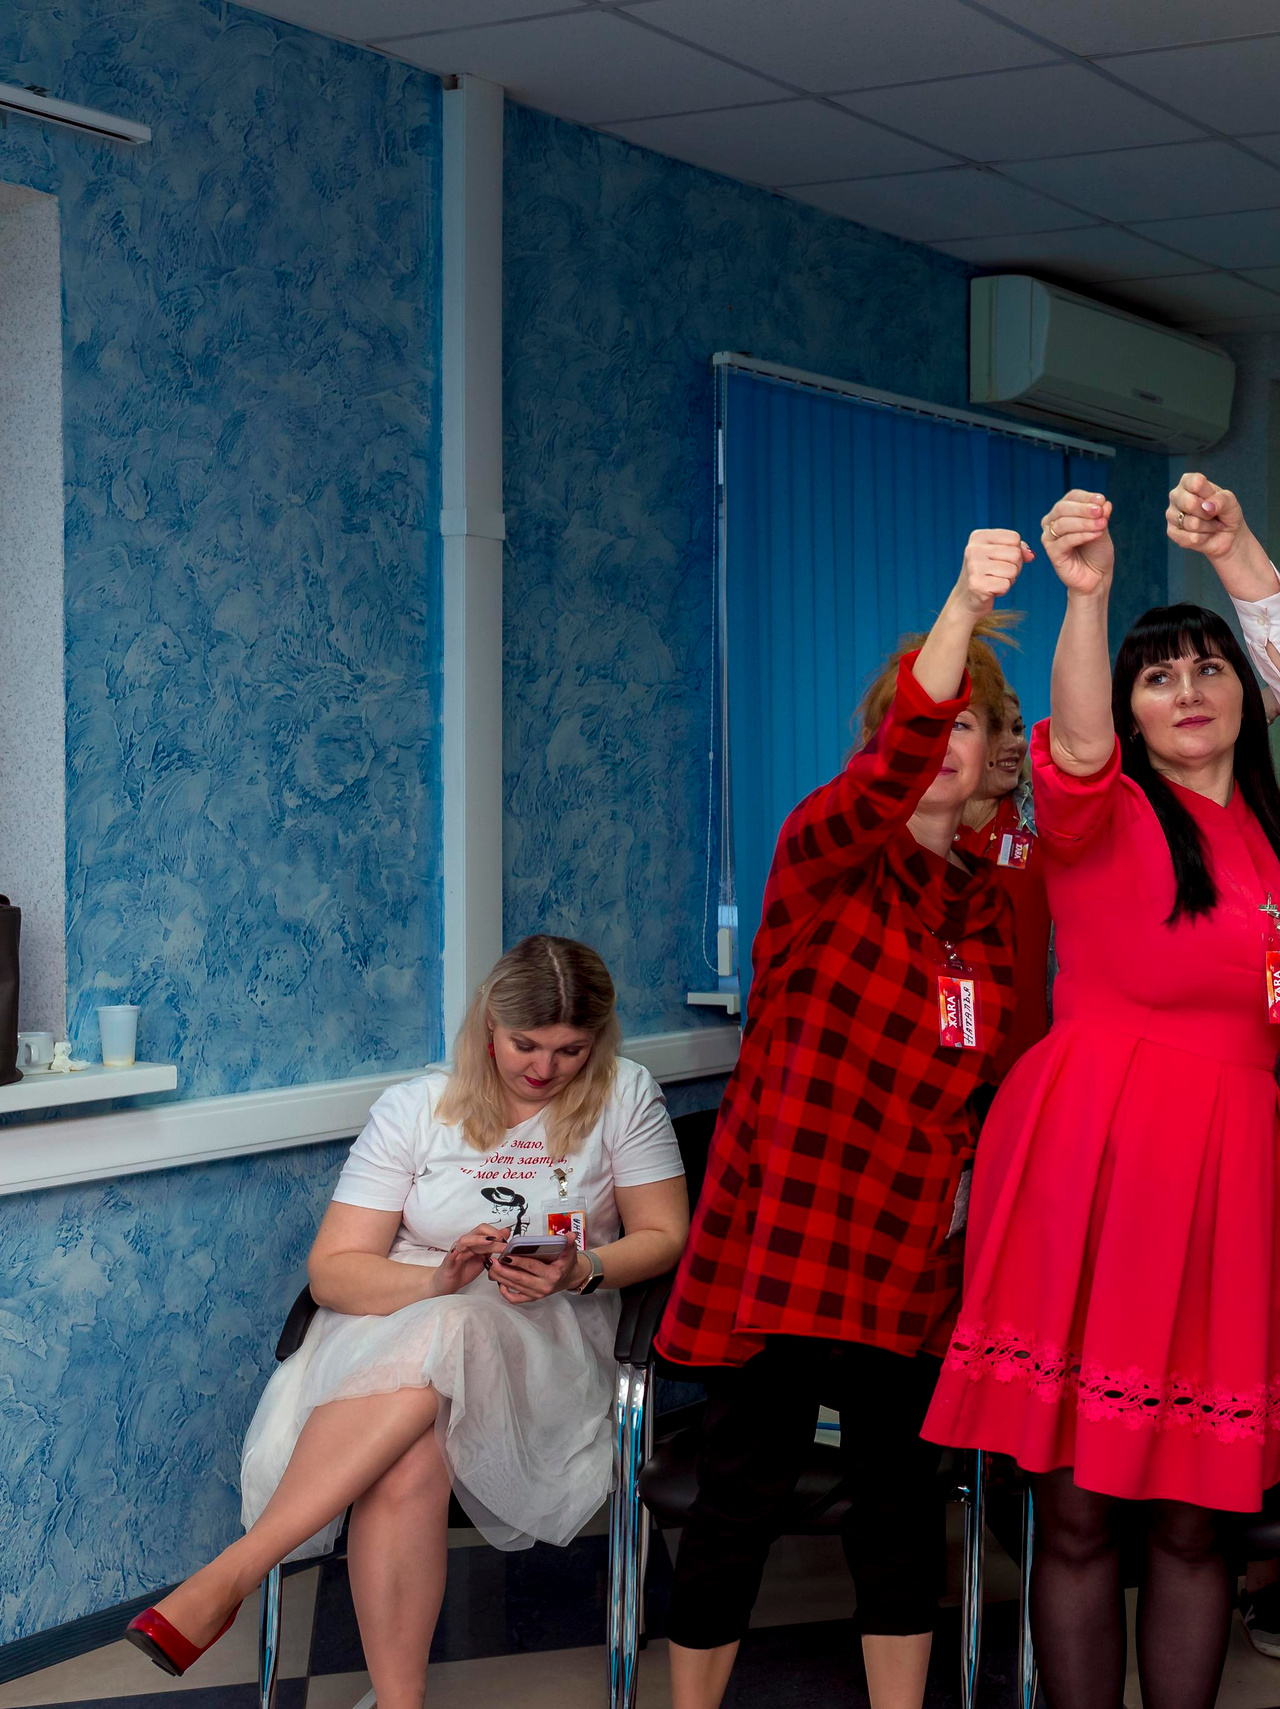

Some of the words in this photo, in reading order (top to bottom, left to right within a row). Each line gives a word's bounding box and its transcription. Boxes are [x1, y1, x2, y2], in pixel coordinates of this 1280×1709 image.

[510, 1139, 544, 1150] знаю,
[480, 1152, 515, 1167] удет
[473, 1170, 500, 1180] мое
[502, 1167, 537, 1180] дело:
